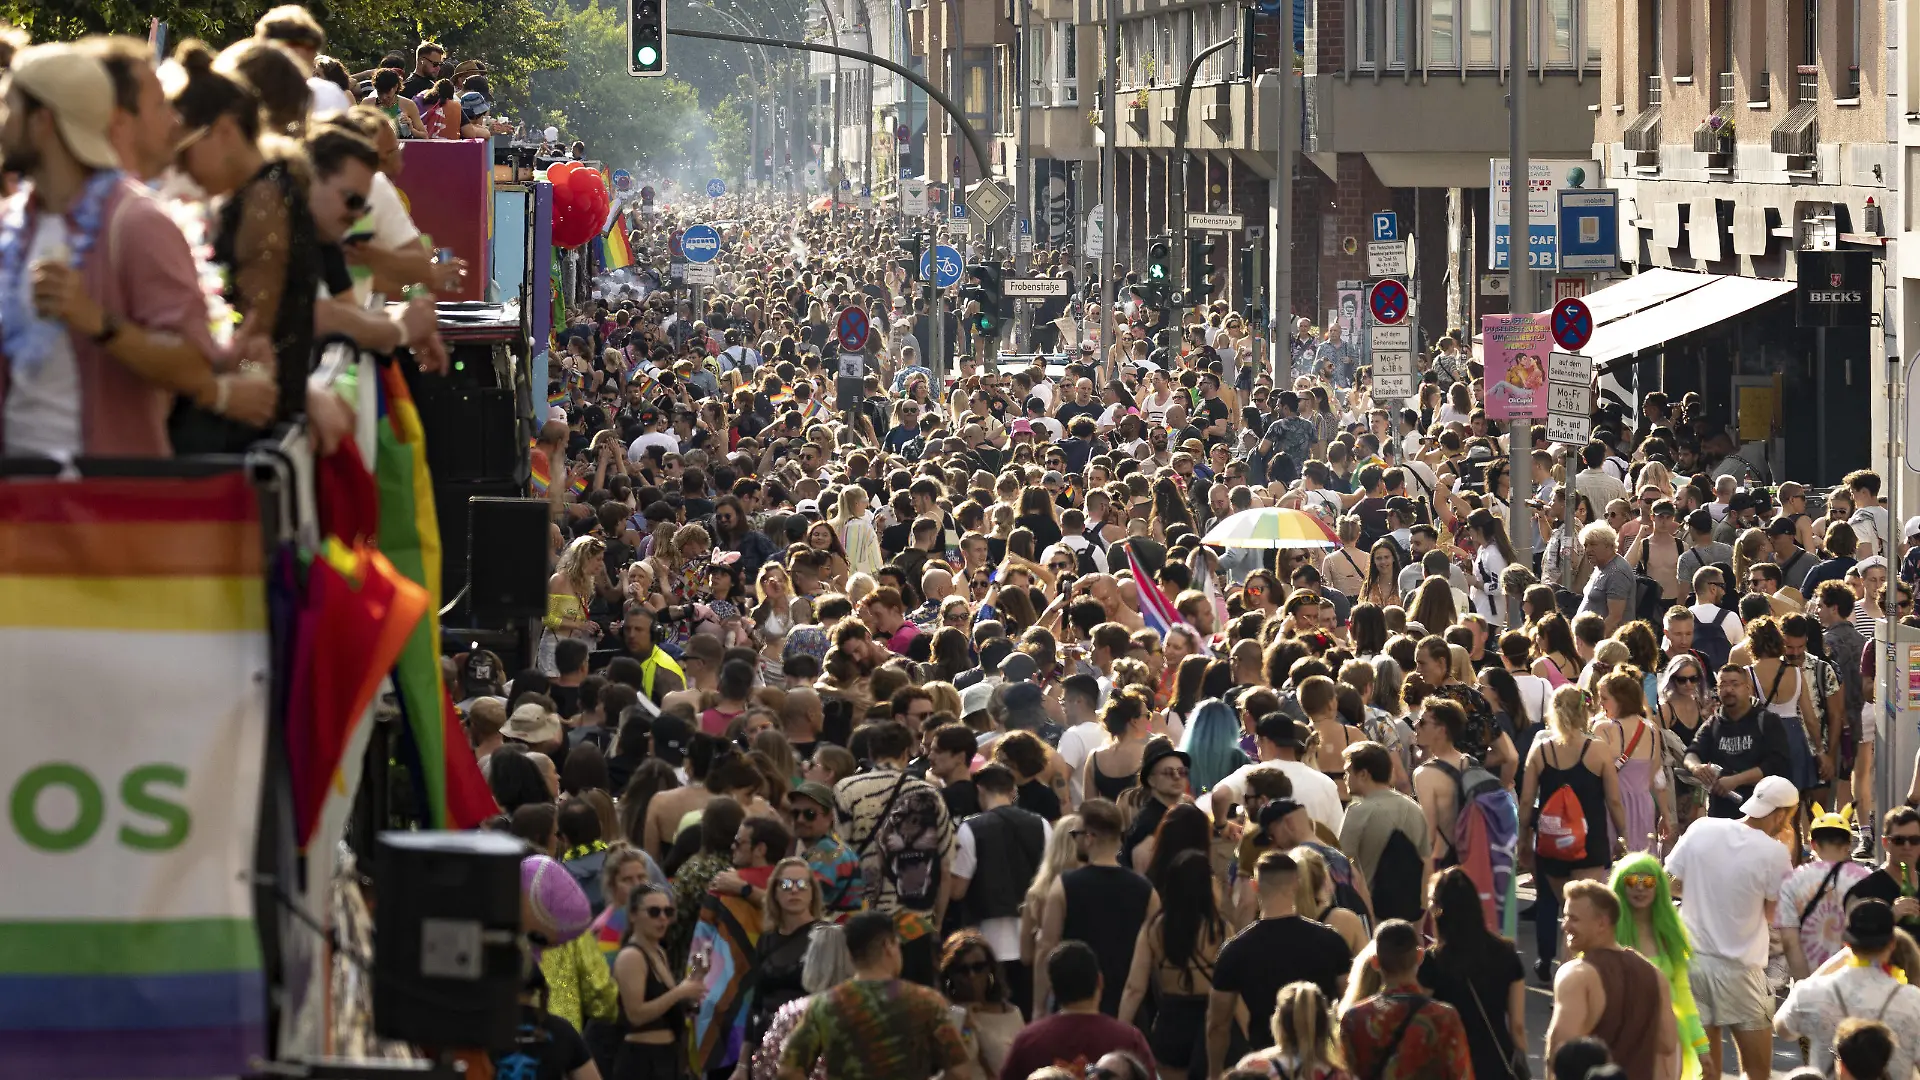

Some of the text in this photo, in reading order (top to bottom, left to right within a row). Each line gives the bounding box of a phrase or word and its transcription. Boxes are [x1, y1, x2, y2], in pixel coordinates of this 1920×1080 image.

[1192, 216, 1237, 226] Frobenstraße
[1377, 216, 1390, 238] P
[1010, 282, 1060, 293] Frobenstraße
[1809, 291, 1861, 302] BECK'S
[1569, 360, 1582, 368] dem
[1550, 367, 1589, 380] Seitenstreifen
[1557, 388, 1580, 399] Mo-Fr
[1508, 397, 1532, 405] OkCupid
[1557, 400, 1573, 410] 6-18
[1556, 418, 1581, 429] Be- und
[1548, 429, 1587, 442] Entladen frei
[9, 761, 192, 853] OS
